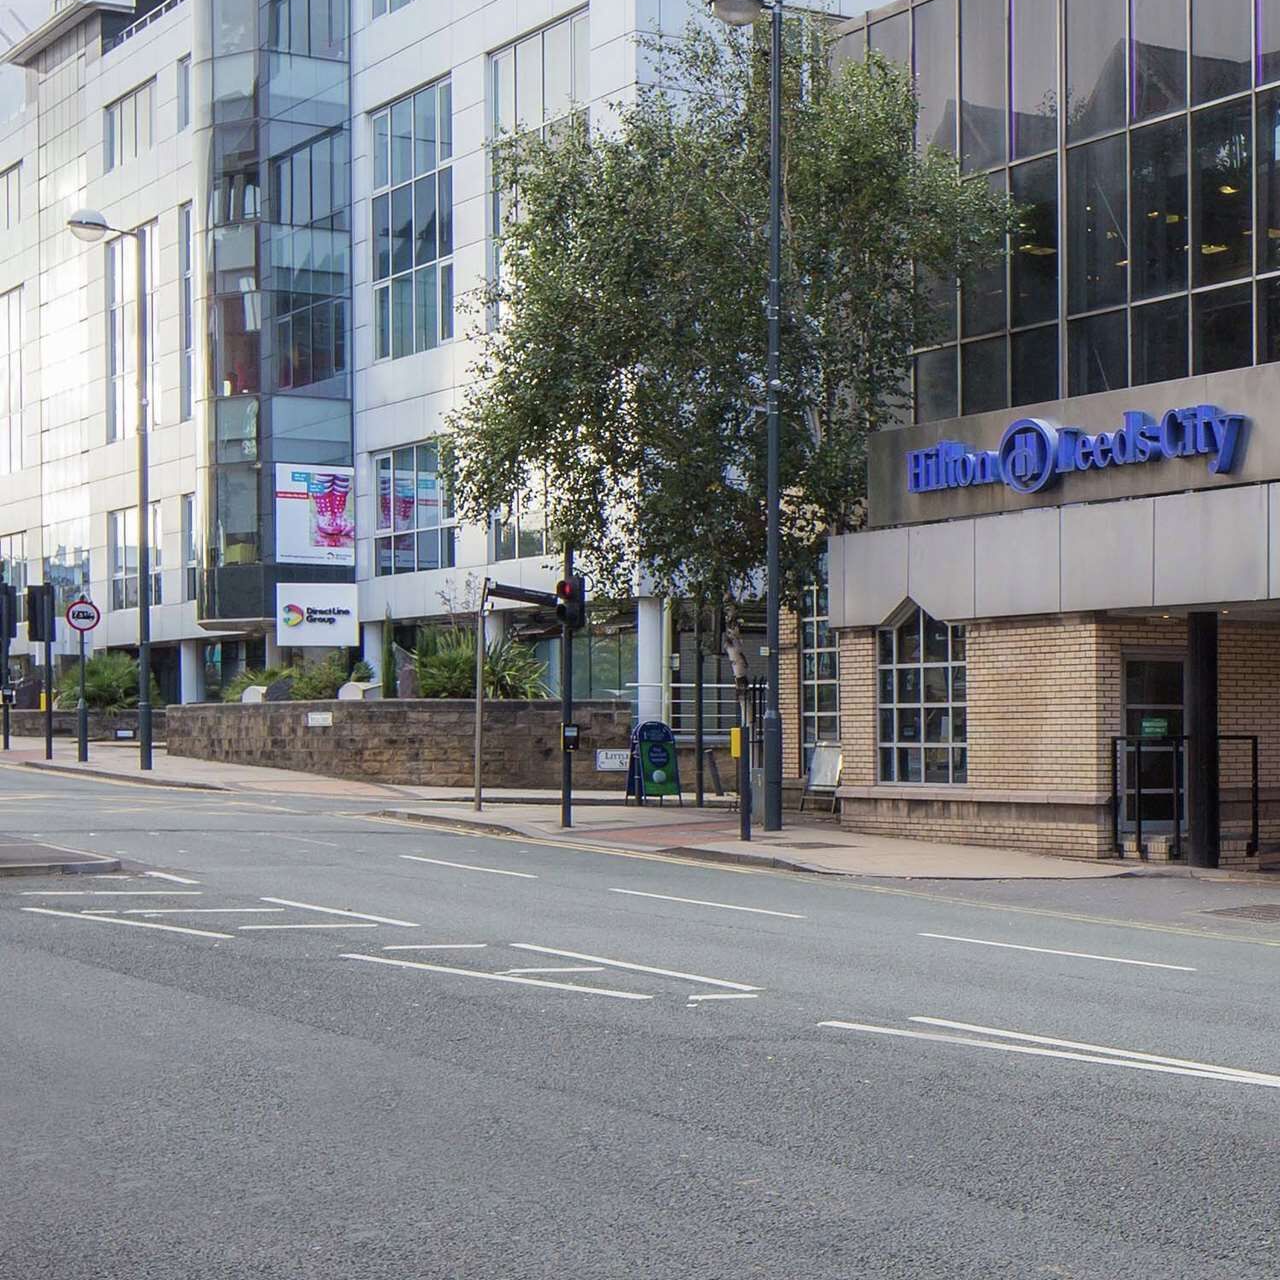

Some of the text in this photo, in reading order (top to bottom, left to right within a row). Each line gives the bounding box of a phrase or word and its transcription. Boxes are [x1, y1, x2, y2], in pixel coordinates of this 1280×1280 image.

[905, 405, 1252, 494] Hilton Leeds City
[306, 607, 350, 615] Direct Line
[306, 615, 336, 624] Group
